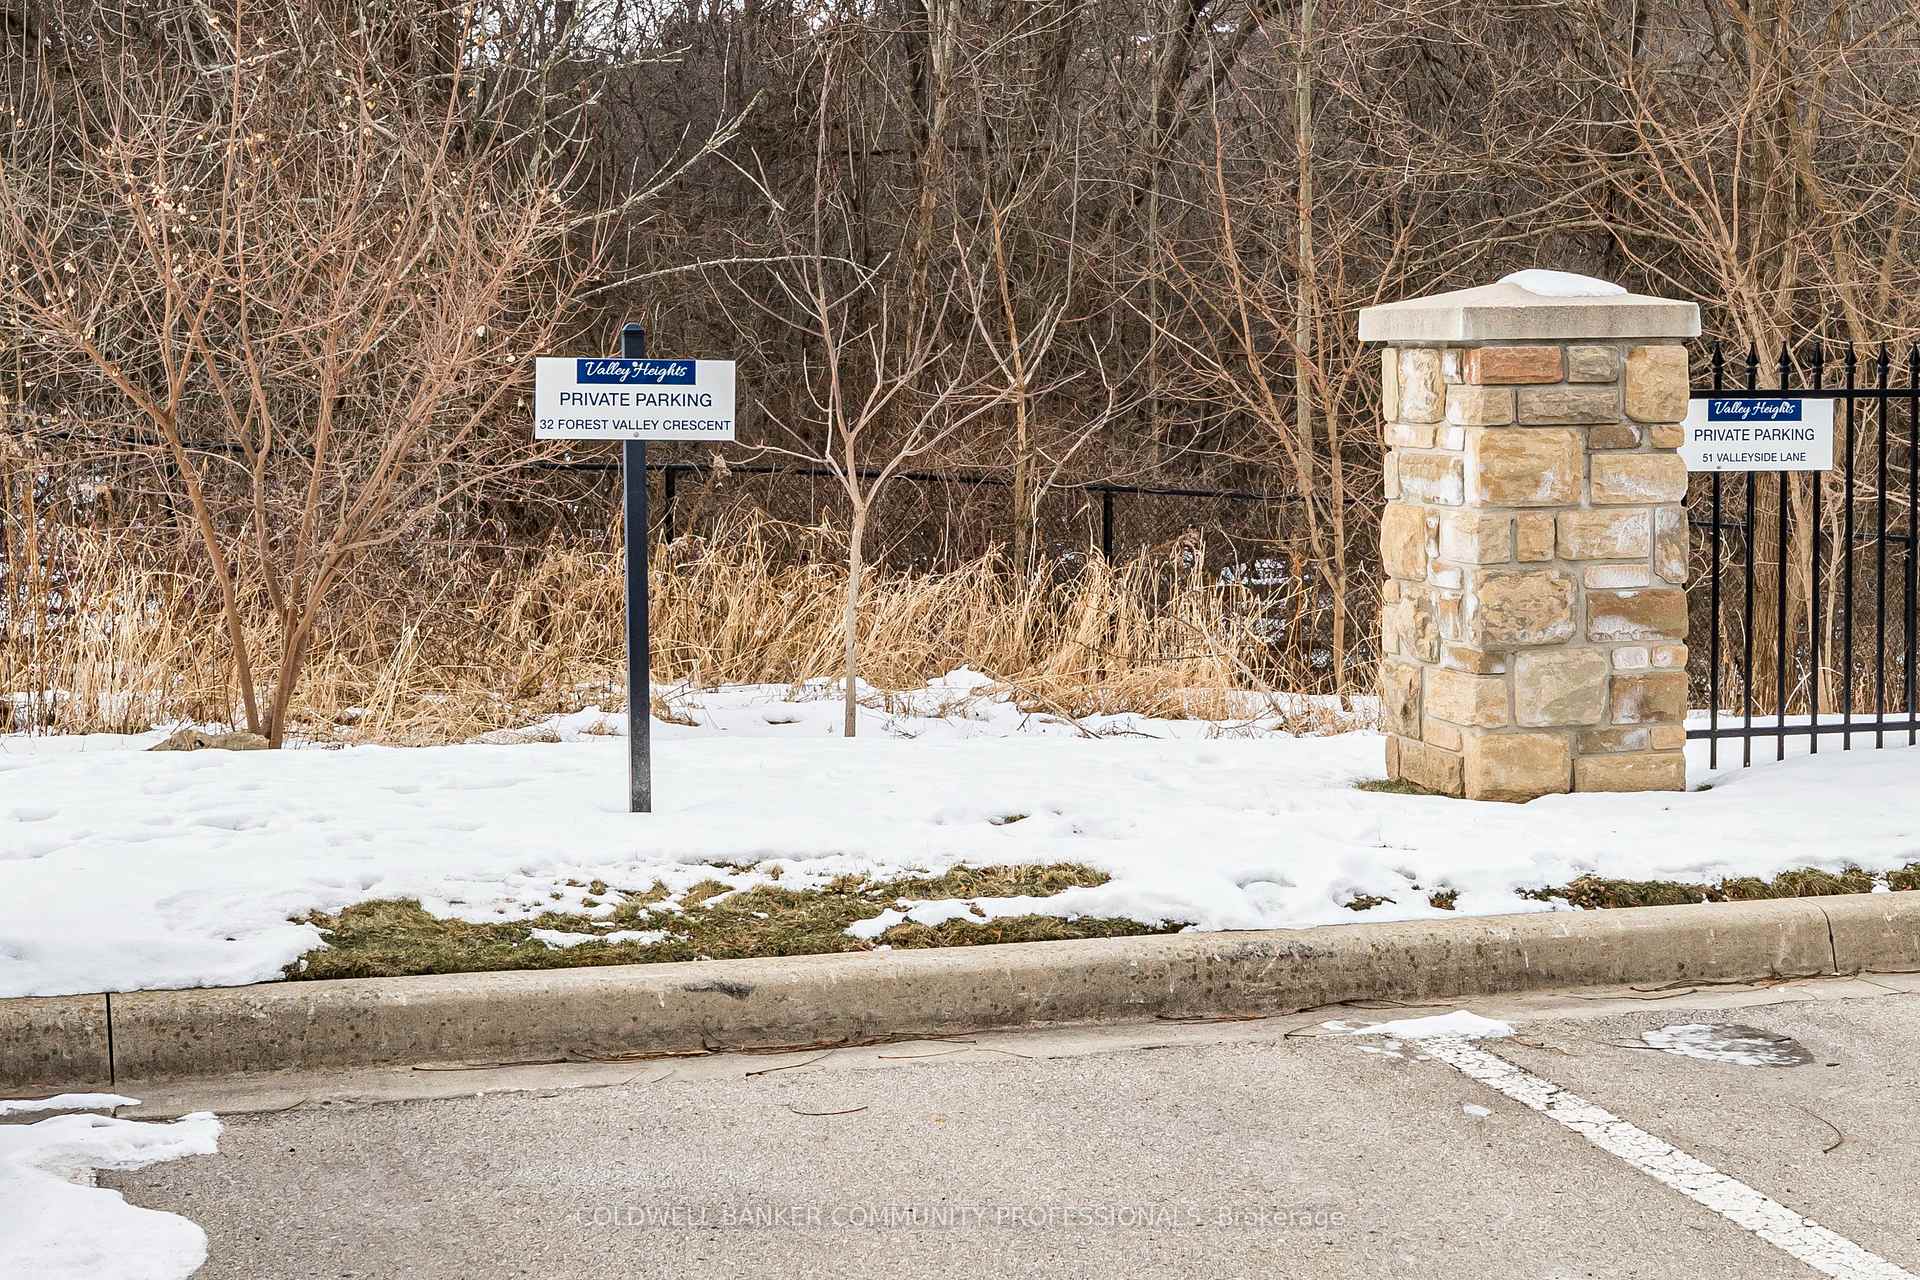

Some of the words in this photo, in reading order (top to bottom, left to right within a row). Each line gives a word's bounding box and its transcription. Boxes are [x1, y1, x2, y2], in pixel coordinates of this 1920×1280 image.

[585, 361, 630, 382] Valley
[632, 361, 688, 383] Heights
[560, 392, 630, 407] PRIVATE
[636, 393, 712, 407] PARKING
[1714, 401, 1751, 420] Valley
[1751, 401, 1796, 420] Heights
[539, 419, 554, 430] 32
[558, 419, 609, 430] FOREST
[612, 419, 659, 431] VALLEY
[662, 420, 731, 431] CRESCENT
[1694, 429, 1750, 441] PRIVATE
[1754, 429, 1815, 441] PARKING
[1702, 453, 1713, 463] 51
[1717, 453, 1777, 462] VALLEYSIDE
[1780, 452, 1806, 462] LANE
